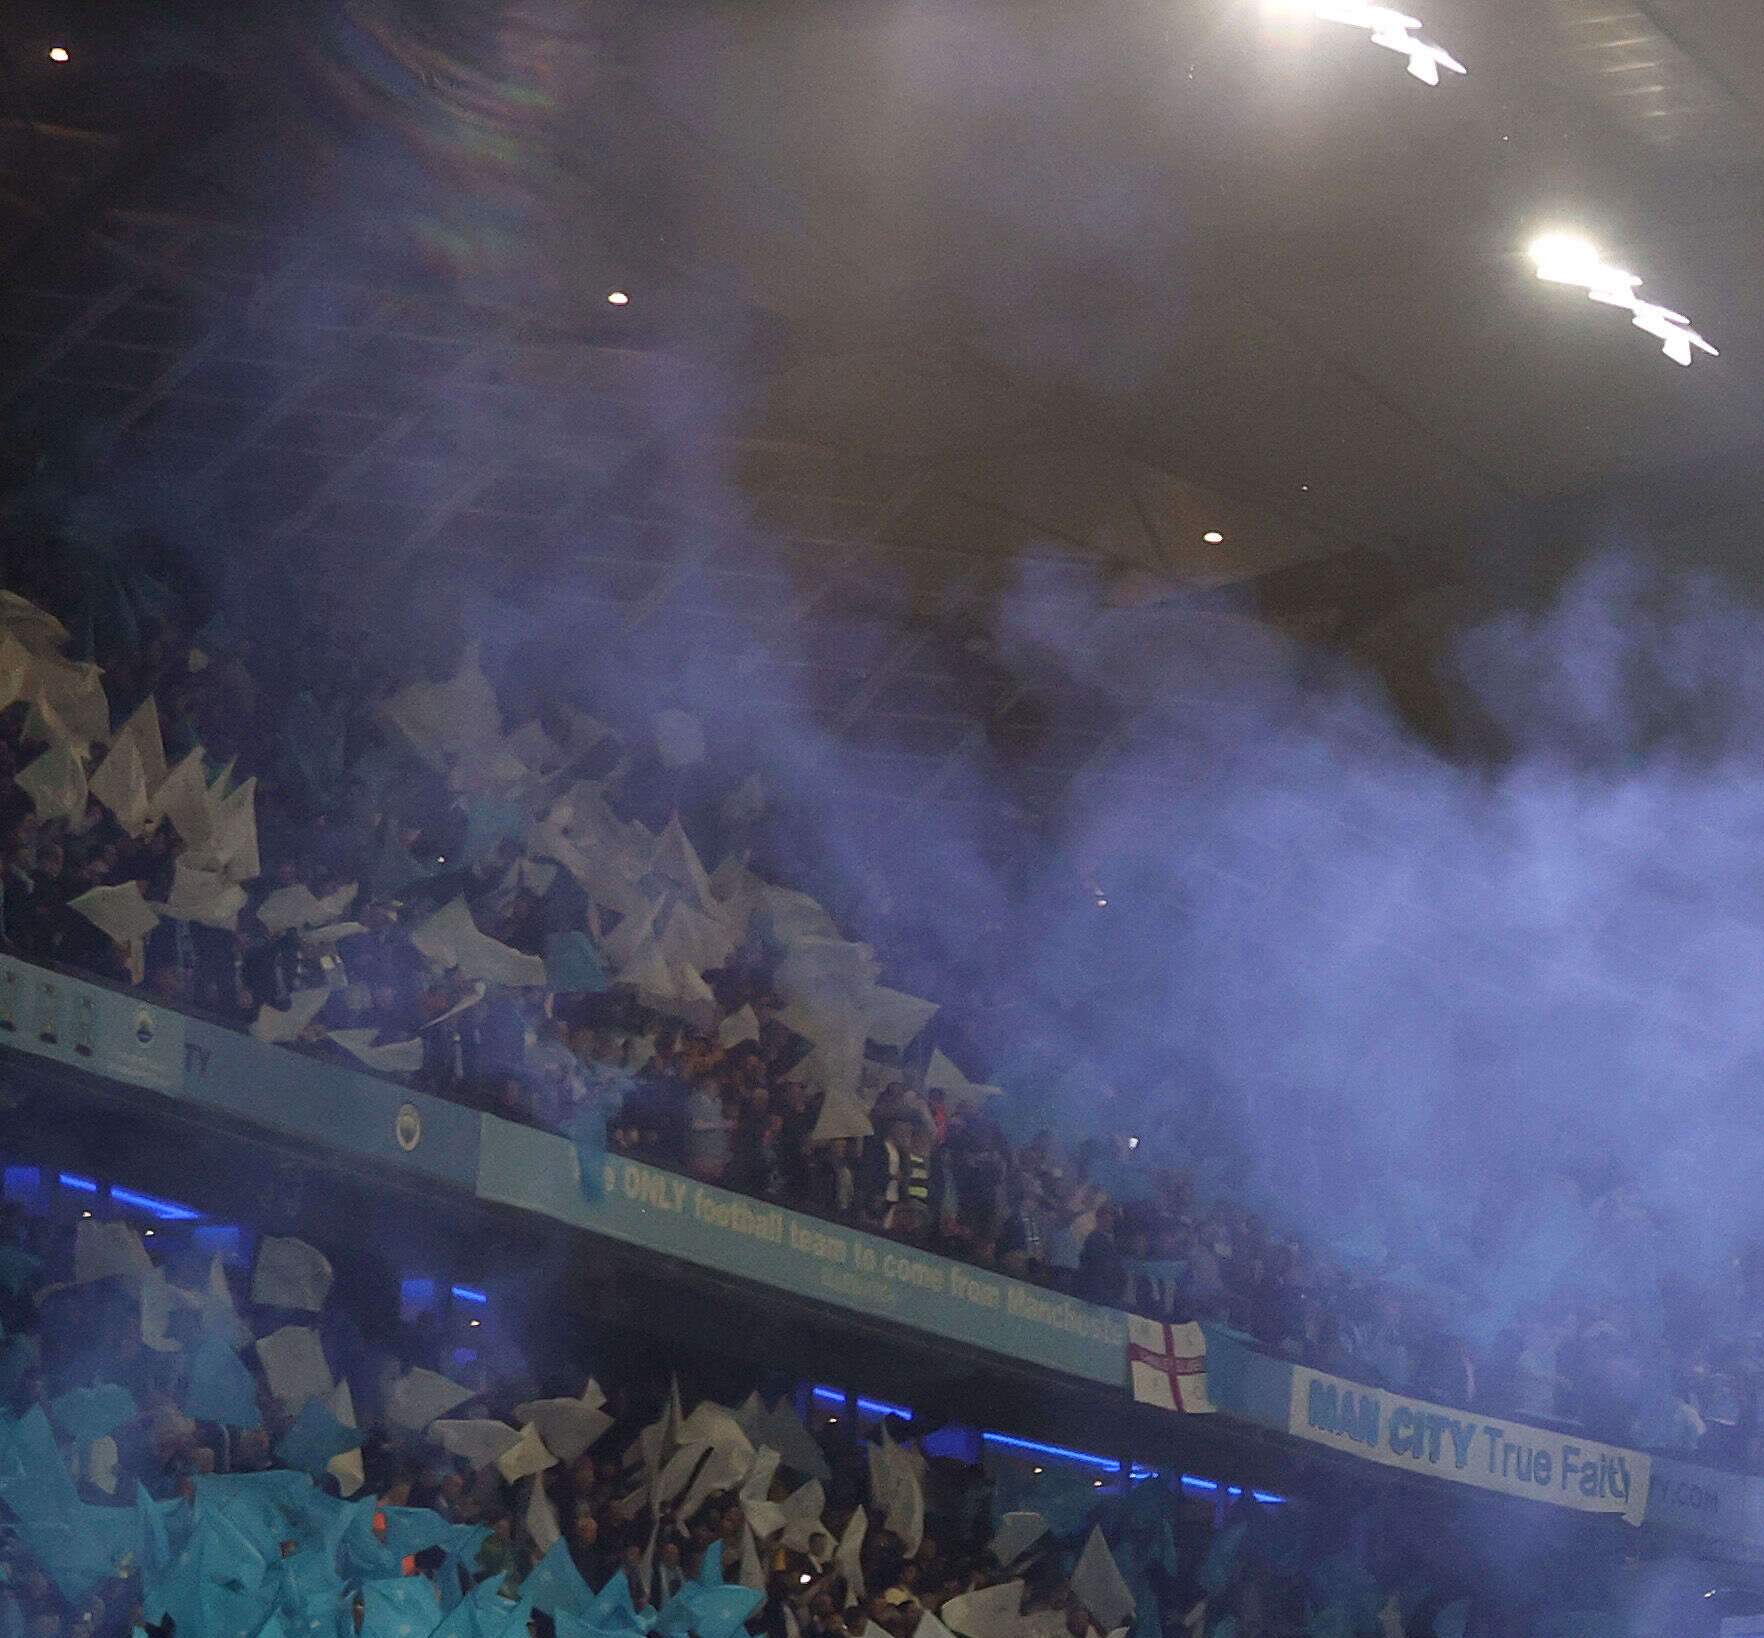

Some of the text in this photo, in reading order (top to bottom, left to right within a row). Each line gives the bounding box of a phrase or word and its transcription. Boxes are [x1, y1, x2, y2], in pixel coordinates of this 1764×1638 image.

[694, 1187, 784, 1244] football
[790, 1219, 847, 1263] team
[883, 1252, 945, 1292] come
[1007, 1285, 1126, 1346] Mancheste
[1307, 1378, 1381, 1448] MAN
[1388, 1406, 1477, 1470] CITY
[1484, 1425, 1551, 1487] True
